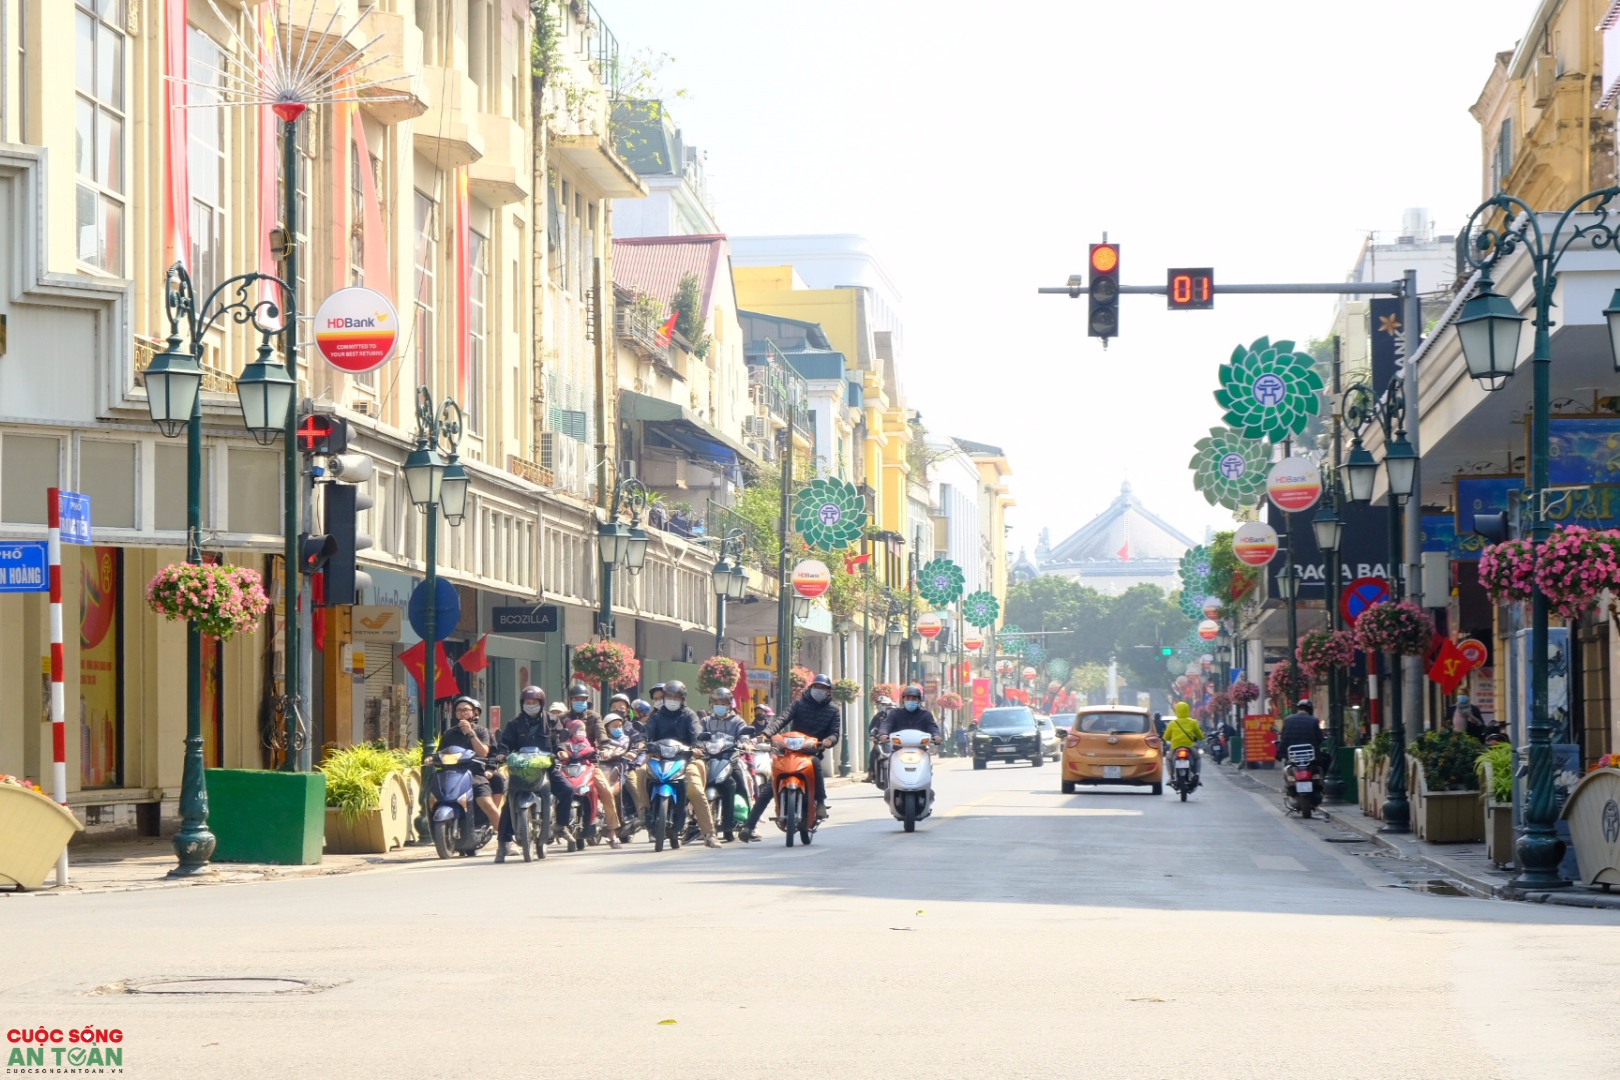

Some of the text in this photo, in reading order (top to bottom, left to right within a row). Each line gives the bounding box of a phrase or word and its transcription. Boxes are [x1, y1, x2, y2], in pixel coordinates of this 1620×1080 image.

[1173, 275, 1209, 303] 01
[327, 317, 375, 329] HDBank
[1275, 475, 1307, 484] HDBank
[0, 547, 22, 560] HỐ
[9, 563, 41, 585] HOÀNG
[500, 614, 549, 624] BOOZILLA
